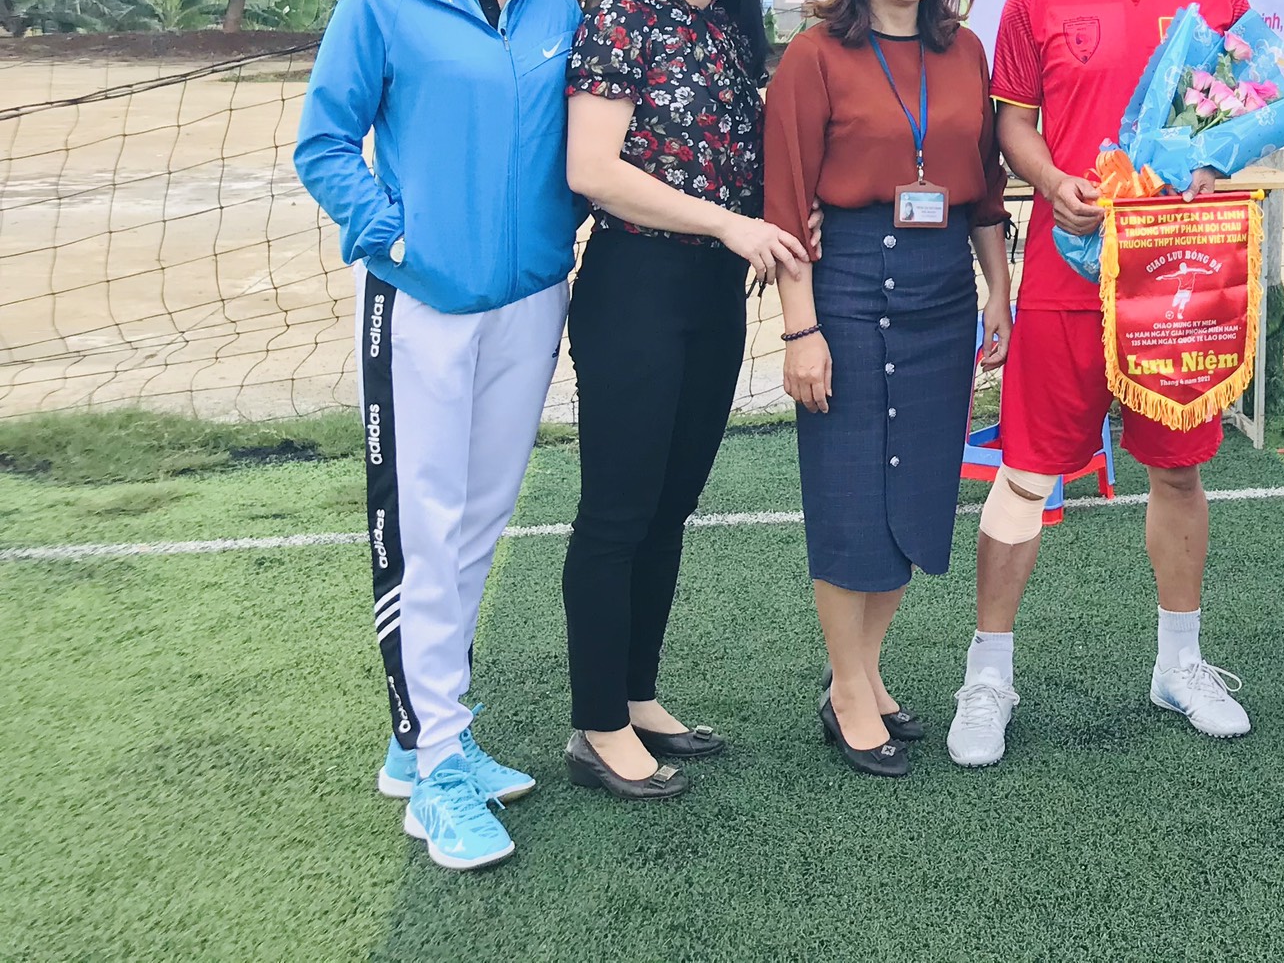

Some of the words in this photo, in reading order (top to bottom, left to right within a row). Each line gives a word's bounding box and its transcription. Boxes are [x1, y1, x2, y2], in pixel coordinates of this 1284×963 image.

[1120, 216, 1155, 225] UBND
[1202, 212, 1214, 220] DI
[1217, 210, 1245, 220] LINH
[1161, 225, 1179, 236] THPT
[1181, 224, 1204, 233] PHAN
[1154, 238, 1173, 247] THPT
[1146, 256, 1165, 273] GIAO
[369, 294, 386, 358] adidas
[1126, 354, 1174, 375] Lưu
[1181, 350, 1238, 374] Niệm
[366, 403, 382, 465] adidas
[373, 508, 388, 569] adidas
